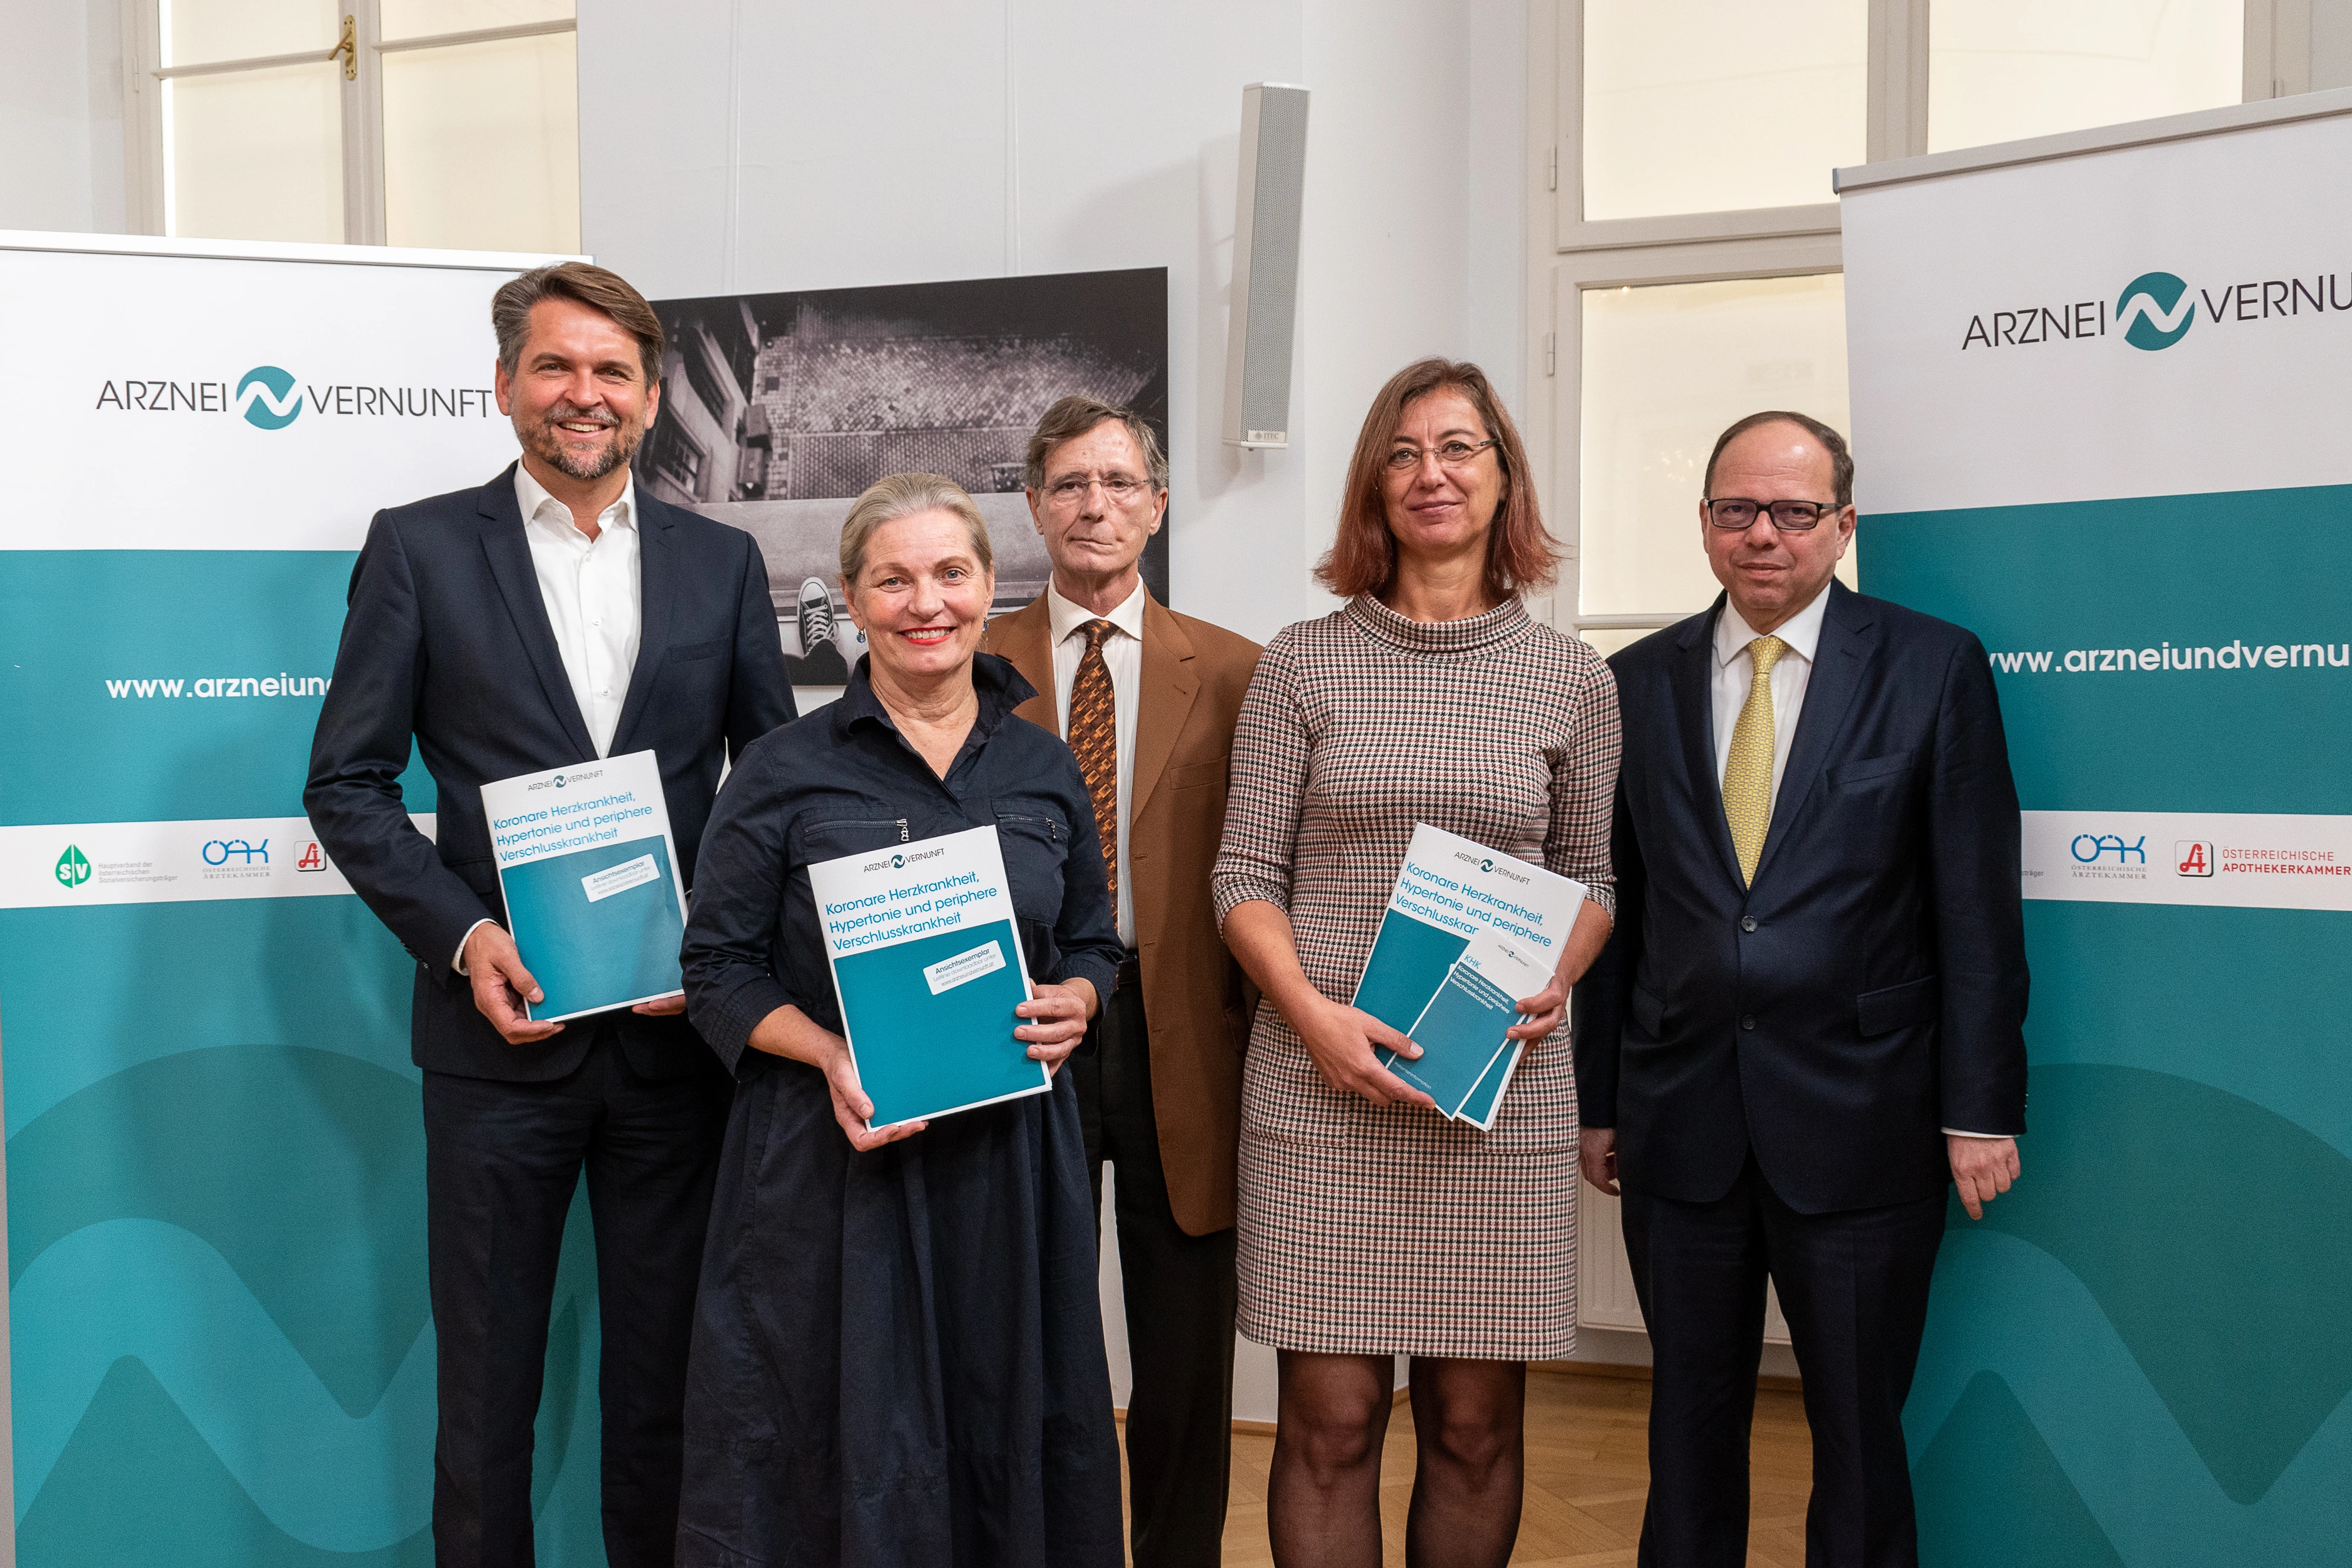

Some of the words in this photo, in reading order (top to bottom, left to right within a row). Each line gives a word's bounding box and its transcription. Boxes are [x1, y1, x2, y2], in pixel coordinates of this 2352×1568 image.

[1962, 301, 2106, 350] ARZNEI
[2201, 271, 2352, 323] VERNU
[96, 380, 227, 412] ARZNEI
[306, 385, 493, 418] VERNUNFT
[105, 673, 332, 698] www.arzneiun
[527, 780, 553, 791] ARZNEI
[566, 770, 604, 784] VERNUNFT
[493, 809, 547, 830] Koronare
[550, 791, 636, 817] Herzkrankheit,
[496, 824, 562, 847] Hypertonie
[566, 816, 590, 831] und
[594, 805, 653, 826] periphere
[499, 828, 618, 862] Verschlusskrankheit
[863, 860, 890, 872] ARZNEI
[904, 848, 945, 863] VERNUNFT
[2223, 846, 2334, 861] ÖSTERREICHISCHE
[98, 875, 178, 883] Sozialversicherungsträger
[593, 861, 644, 884] Ansichtsexemplar
[1454, 851, 1480, 865] ARZNEI
[1494, 866, 1531, 885] VERNUNFT
[2071, 864, 2147, 872] ÖSTERREICHISCHE
[2072, 871, 2147, 880] ÄRZTEKAMMER
[2222, 863, 2351, 875] APOTHEKERKAMMER
[825, 892, 886, 915] Koronare
[888, 871, 980, 901] Herzkrankheit,
[1406, 861, 1459, 891] Koronare
[1461, 884, 1544, 926] Herzkrankheit,
[829, 908, 901, 934] Hypertonie
[905, 900, 932, 916] und
[935, 887, 997, 912] periphere
[1400, 877, 1463, 911] Hypertonie
[1466, 905, 1490, 922] und
[1492, 916, 1552, 947] periphere
[833, 912, 961, 951] Verschlusskrankheit
[936, 948, 990, 974] Ansichtsexemplar
[1457, 964, 1479, 982] Koronare
[1464, 954, 1482, 969] KHK
[1453, 971, 1479, 991] Hypertonie
[1478, 988, 1489, 998] und
[1488, 995, 1510, 1014] periphere
